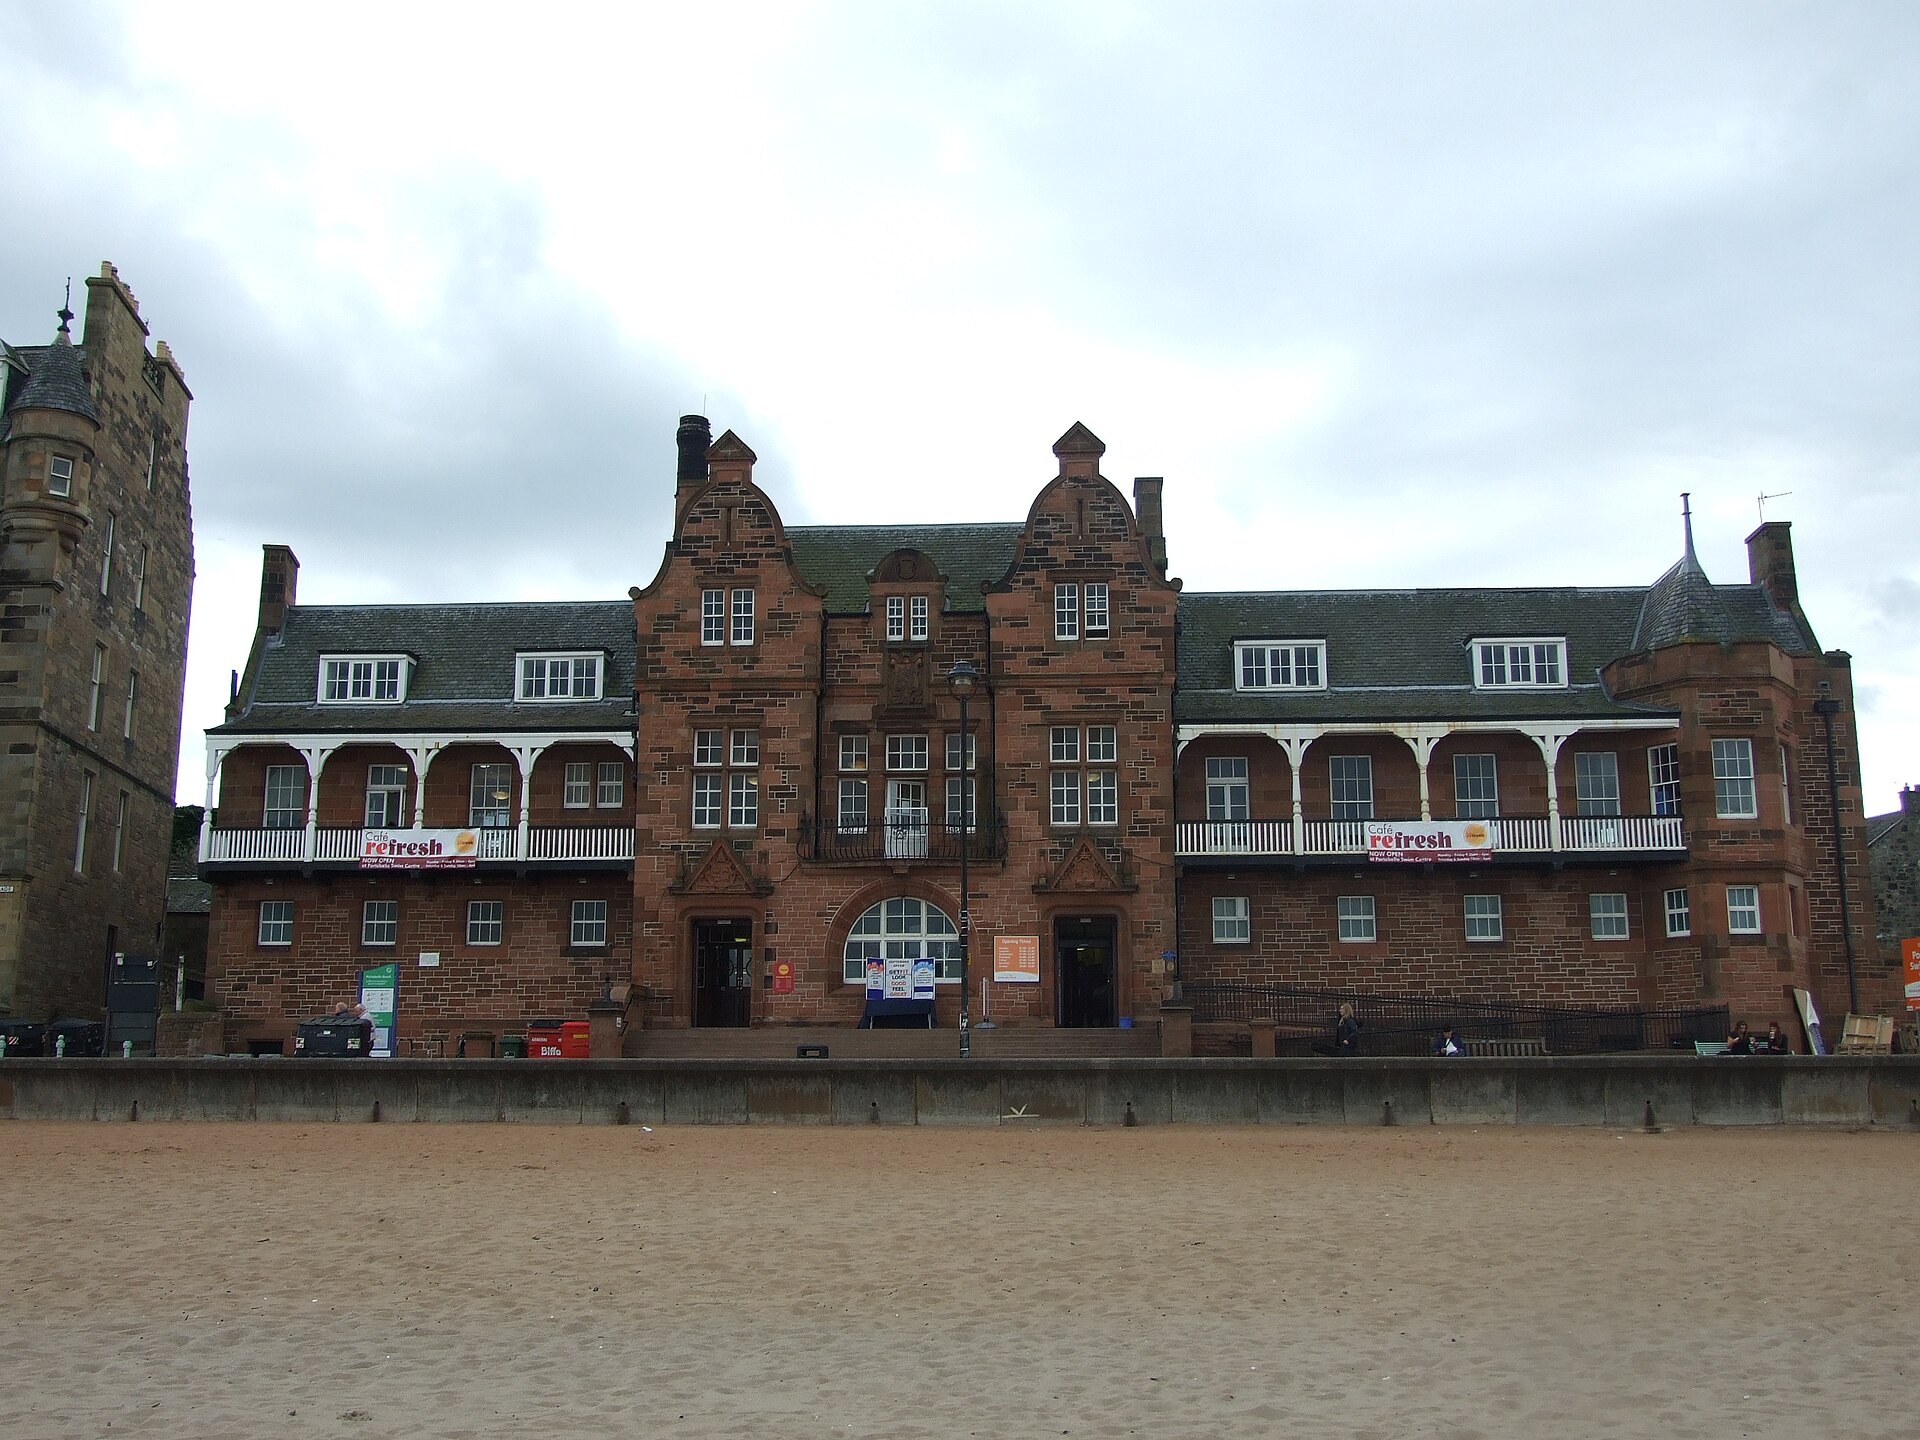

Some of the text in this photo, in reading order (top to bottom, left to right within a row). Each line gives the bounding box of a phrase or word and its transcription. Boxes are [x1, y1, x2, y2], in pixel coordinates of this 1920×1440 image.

[1368, 824, 1393, 835] Café
[365, 831, 389, 842] Café
[1369, 832, 1452, 849] refresh
[365, 839, 443, 856] refresh
[541, 1046, 561, 1056] Biffa
